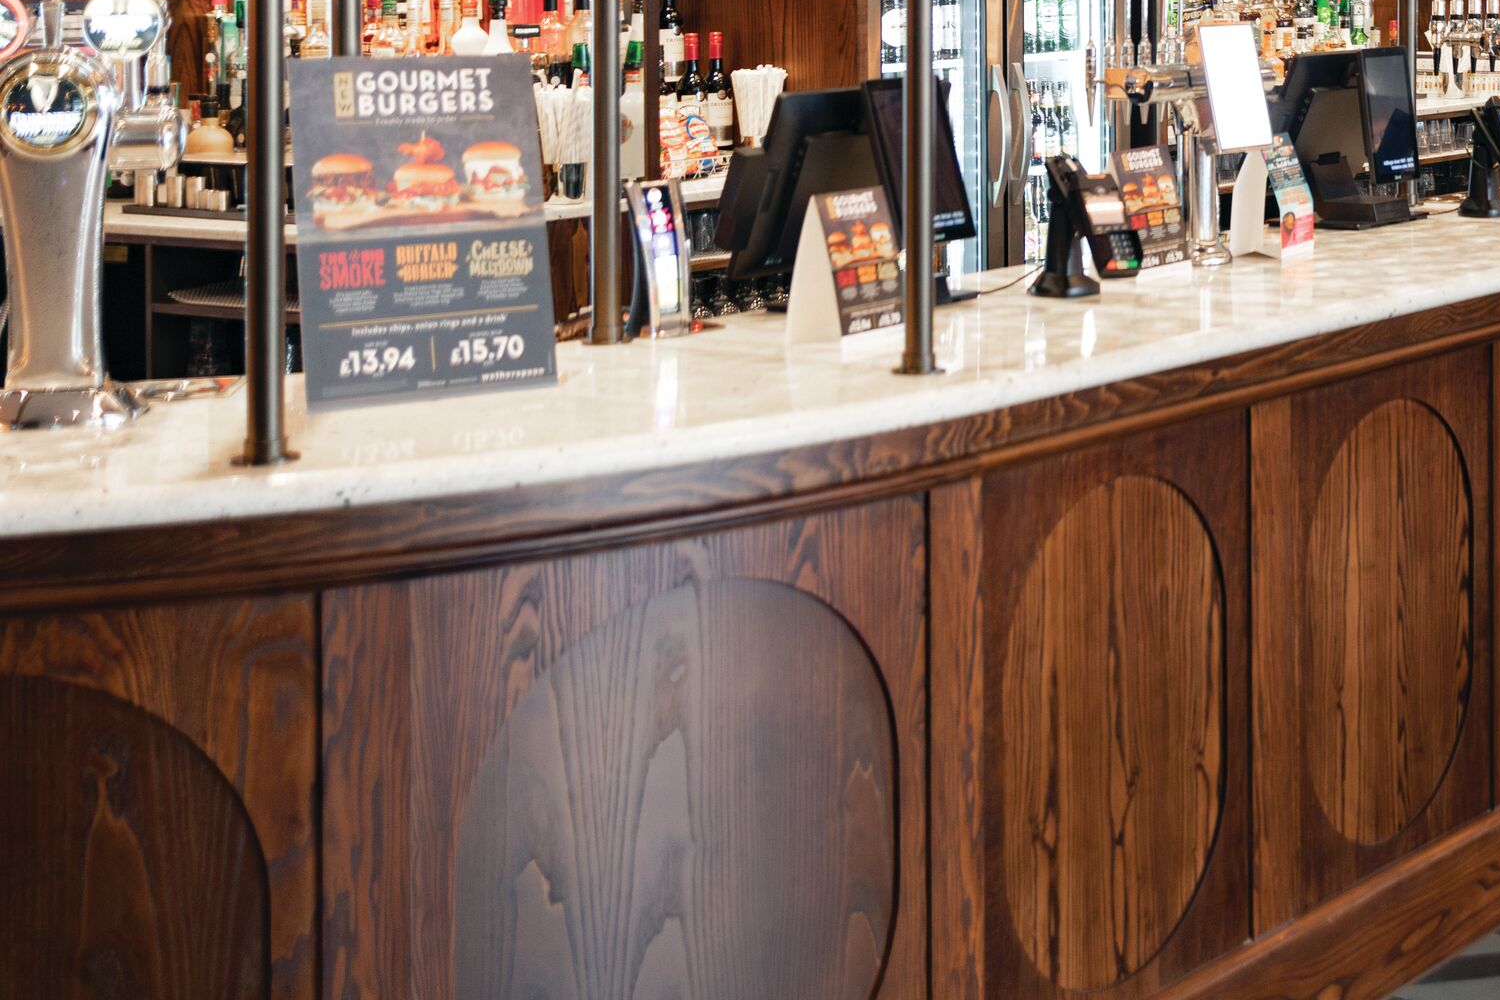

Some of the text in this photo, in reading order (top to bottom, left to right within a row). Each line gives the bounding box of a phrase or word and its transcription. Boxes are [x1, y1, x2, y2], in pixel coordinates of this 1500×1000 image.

[355, 68, 493, 94] GOURMET
[357, 89, 495, 118] BURGERS
[395, 241, 458, 266] BUFFALO
[470, 239, 527, 259] CHEESE
[320, 260, 386, 291] SMOKE
[469, 255, 534, 277] MELTDOWN
[351, 325, 387, 337] Includes
[389, 322, 415, 336] chips,
[415, 320, 439, 331] onion
[440, 318, 460, 331] rings
[461, 316, 477, 327] and
[339, 345, 417, 378] £13.94
[449, 334, 525, 367] £15.70
[481, 366, 545, 383] wetherspoon
